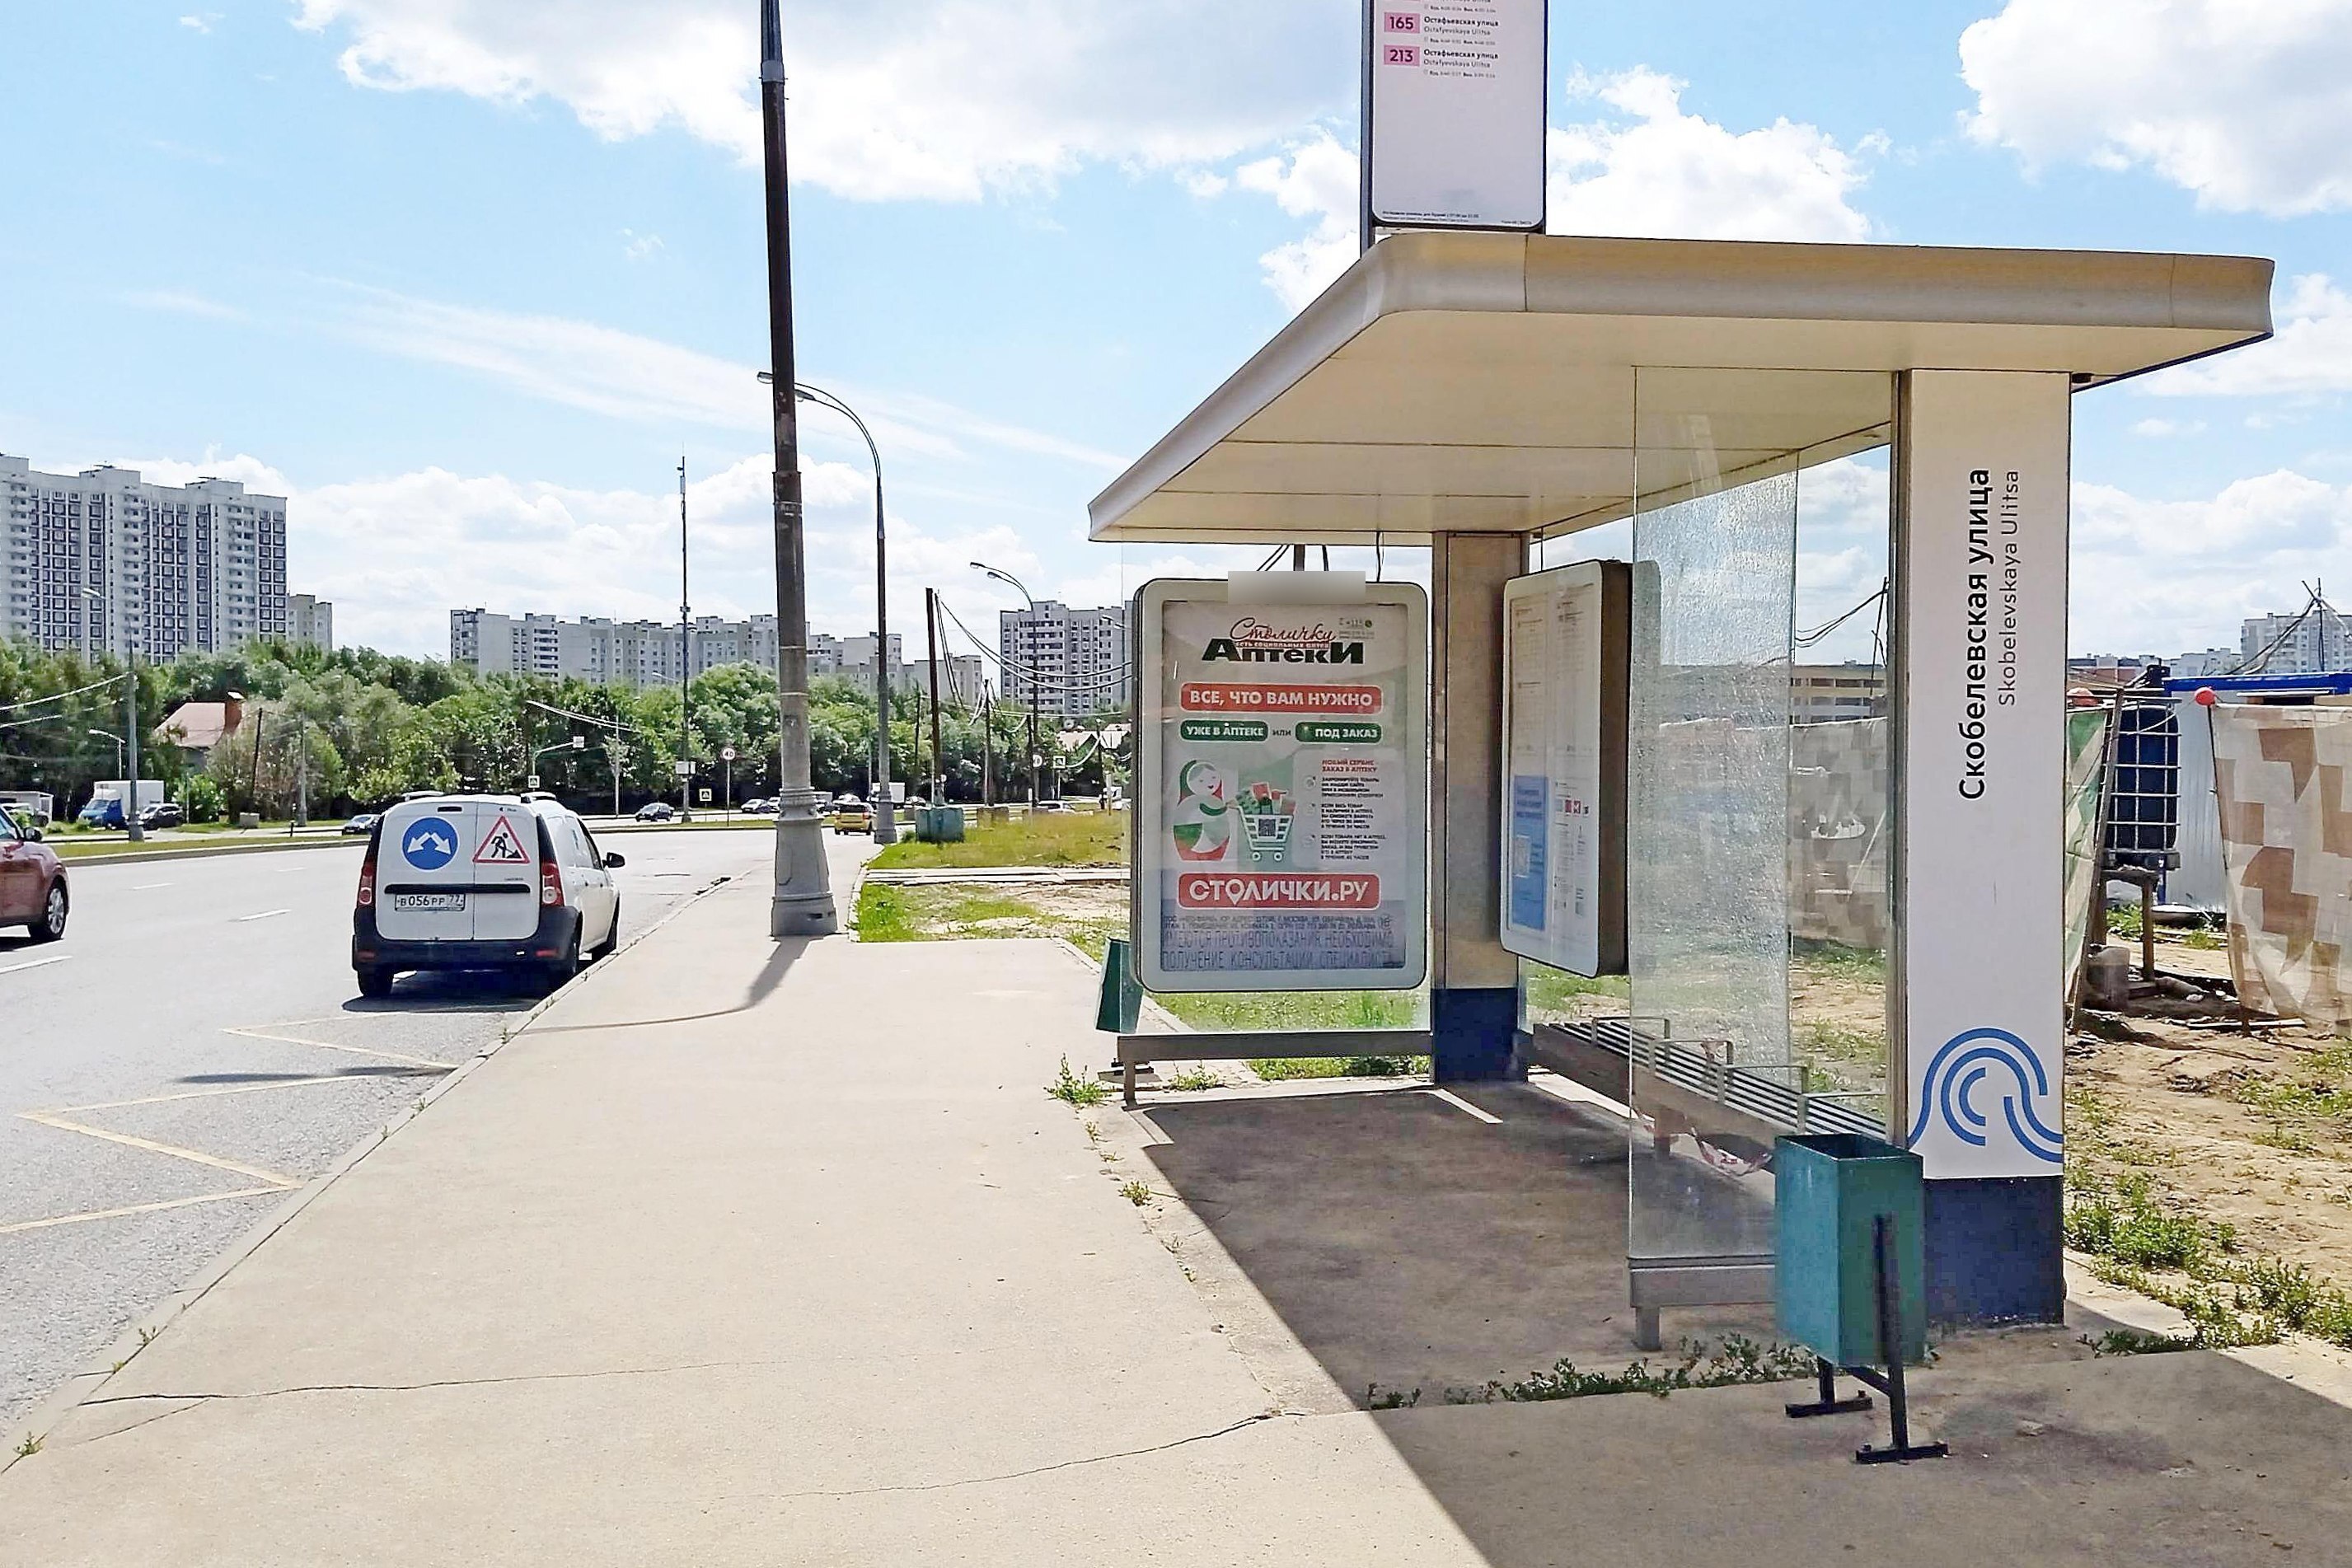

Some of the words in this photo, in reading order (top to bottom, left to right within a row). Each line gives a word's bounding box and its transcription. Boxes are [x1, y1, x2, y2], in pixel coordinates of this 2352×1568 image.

[1389, 16, 1414, 30] 165
[1389, 49, 1413, 63] 213
[1999, 470, 2020, 535] Ulitsa
[1969, 468, 1994, 564] улица
[1230, 617, 1336, 642] Столички
[1998, 542, 2022, 706] Skobelevskaya
[1190, 690, 1225, 706] ВСЕ,
[1230, 691, 1262, 704] ЧТО
[1267, 692, 1303, 706] ВАМ
[1308, 693, 1373, 706] НУЖНО
[1958, 573, 1989, 799] Скобелевская
[1186, 726, 1211, 736] УЖЕ
[1212, 727, 1221, 736] В
[1224, 727, 1264, 737] АПТЕКЕ
[1315, 728, 1340, 739] ПОД
[1342, 728, 1378, 738] ЗАКАЗ
[1189, 878, 1369, 906] СТОЛИЧКИ.РУ
